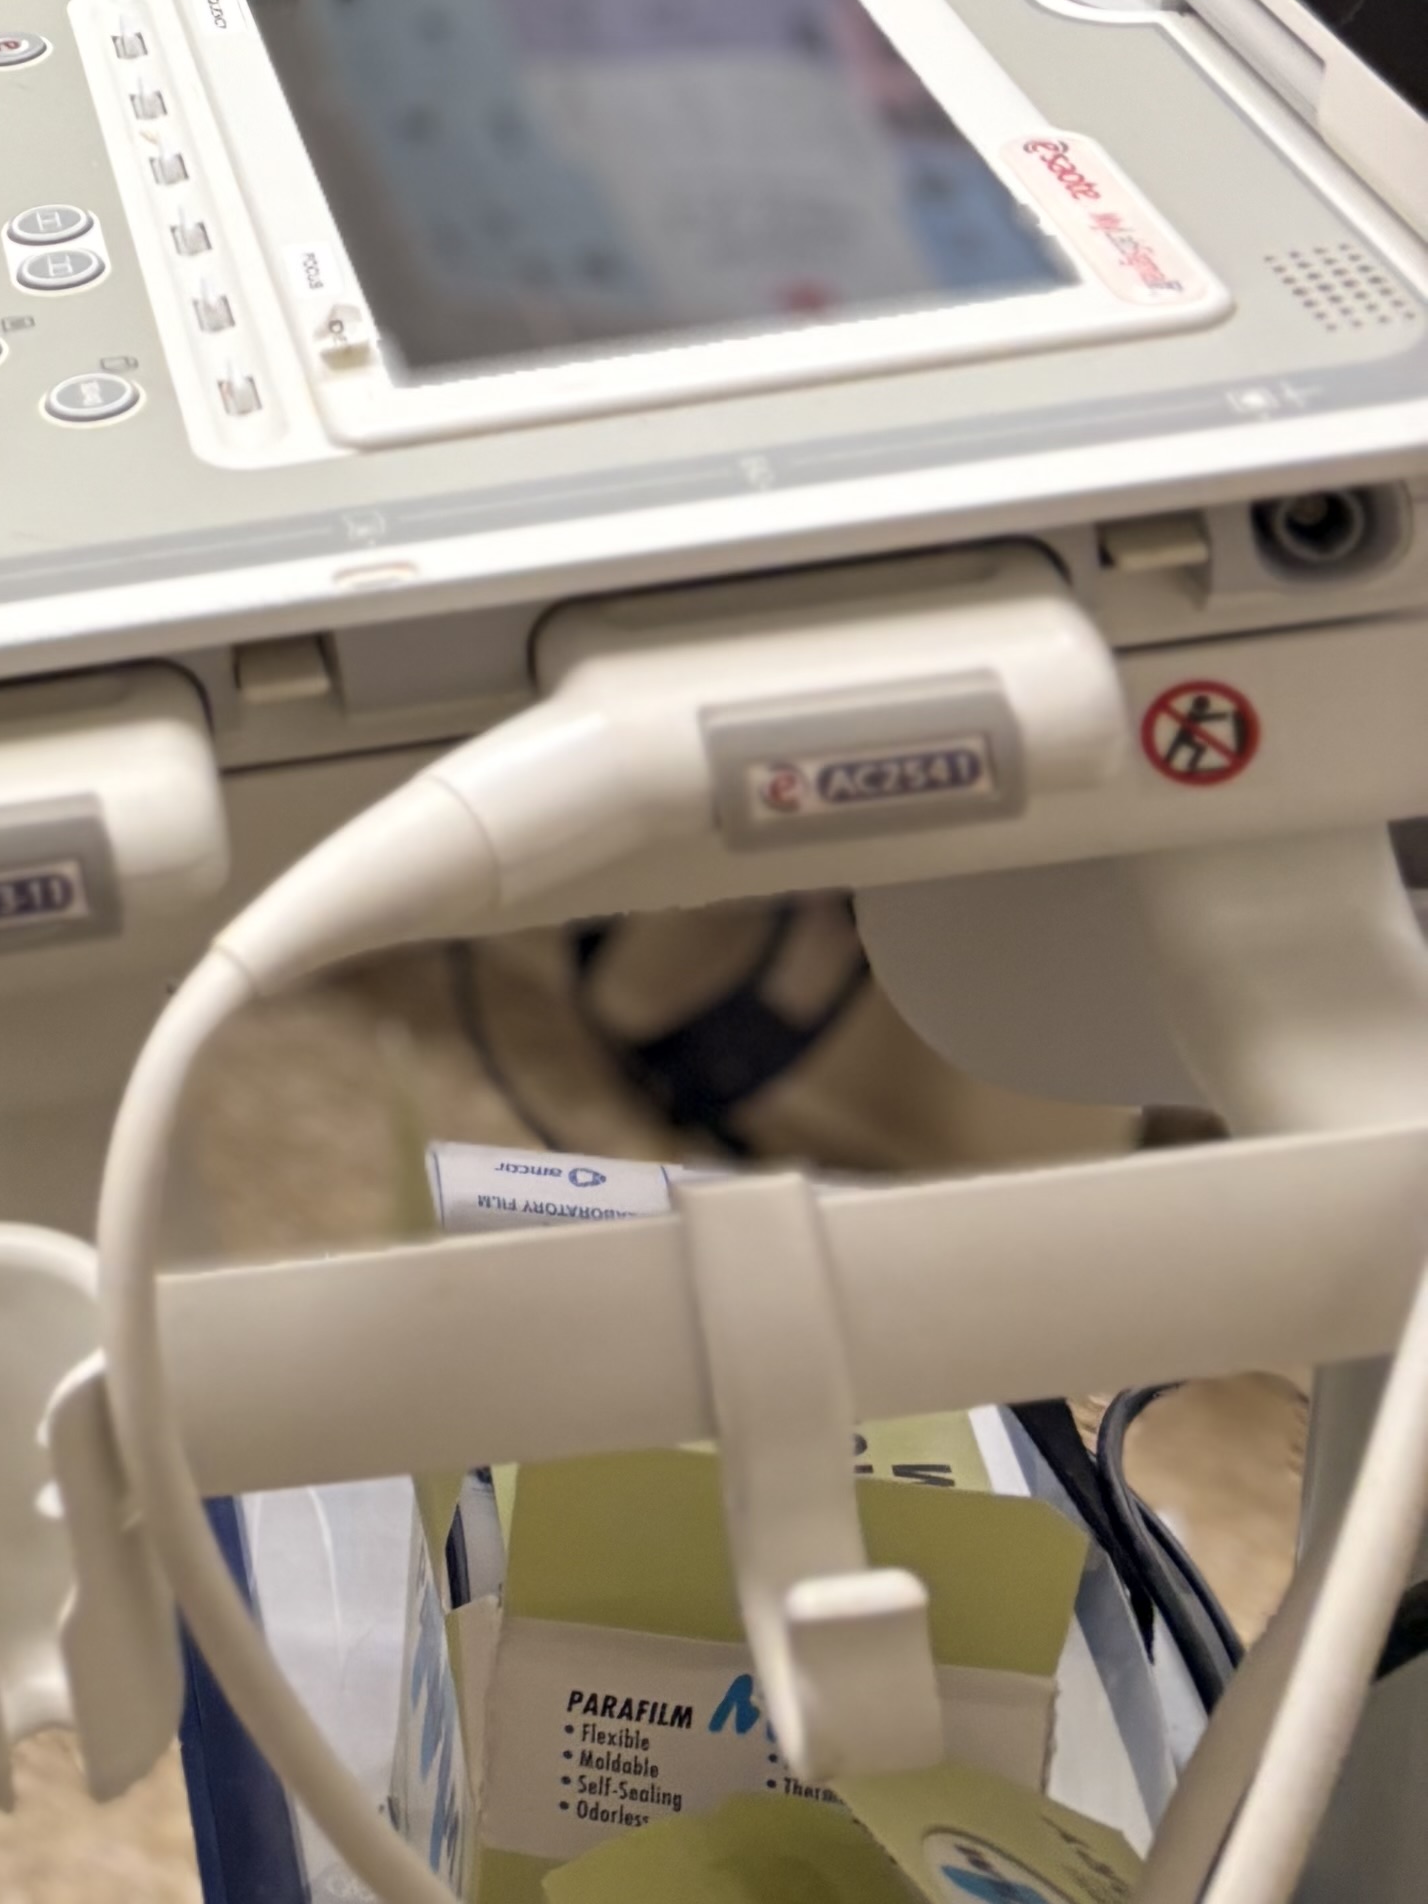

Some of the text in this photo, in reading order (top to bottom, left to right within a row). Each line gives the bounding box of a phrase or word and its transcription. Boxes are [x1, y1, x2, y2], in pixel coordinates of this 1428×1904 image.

[494, 1161, 563, 1179] amcor
[476, 1194, 517, 1212] FILM
[566, 1689, 693, 1729] PARAFILM
[581, 1723, 651, 1751] Flexible
[579, 1749, 660, 1779] Moldable
[576, 1775, 684, 1812] Self-Sealing
[783, 1776, 846, 1805] Therm
